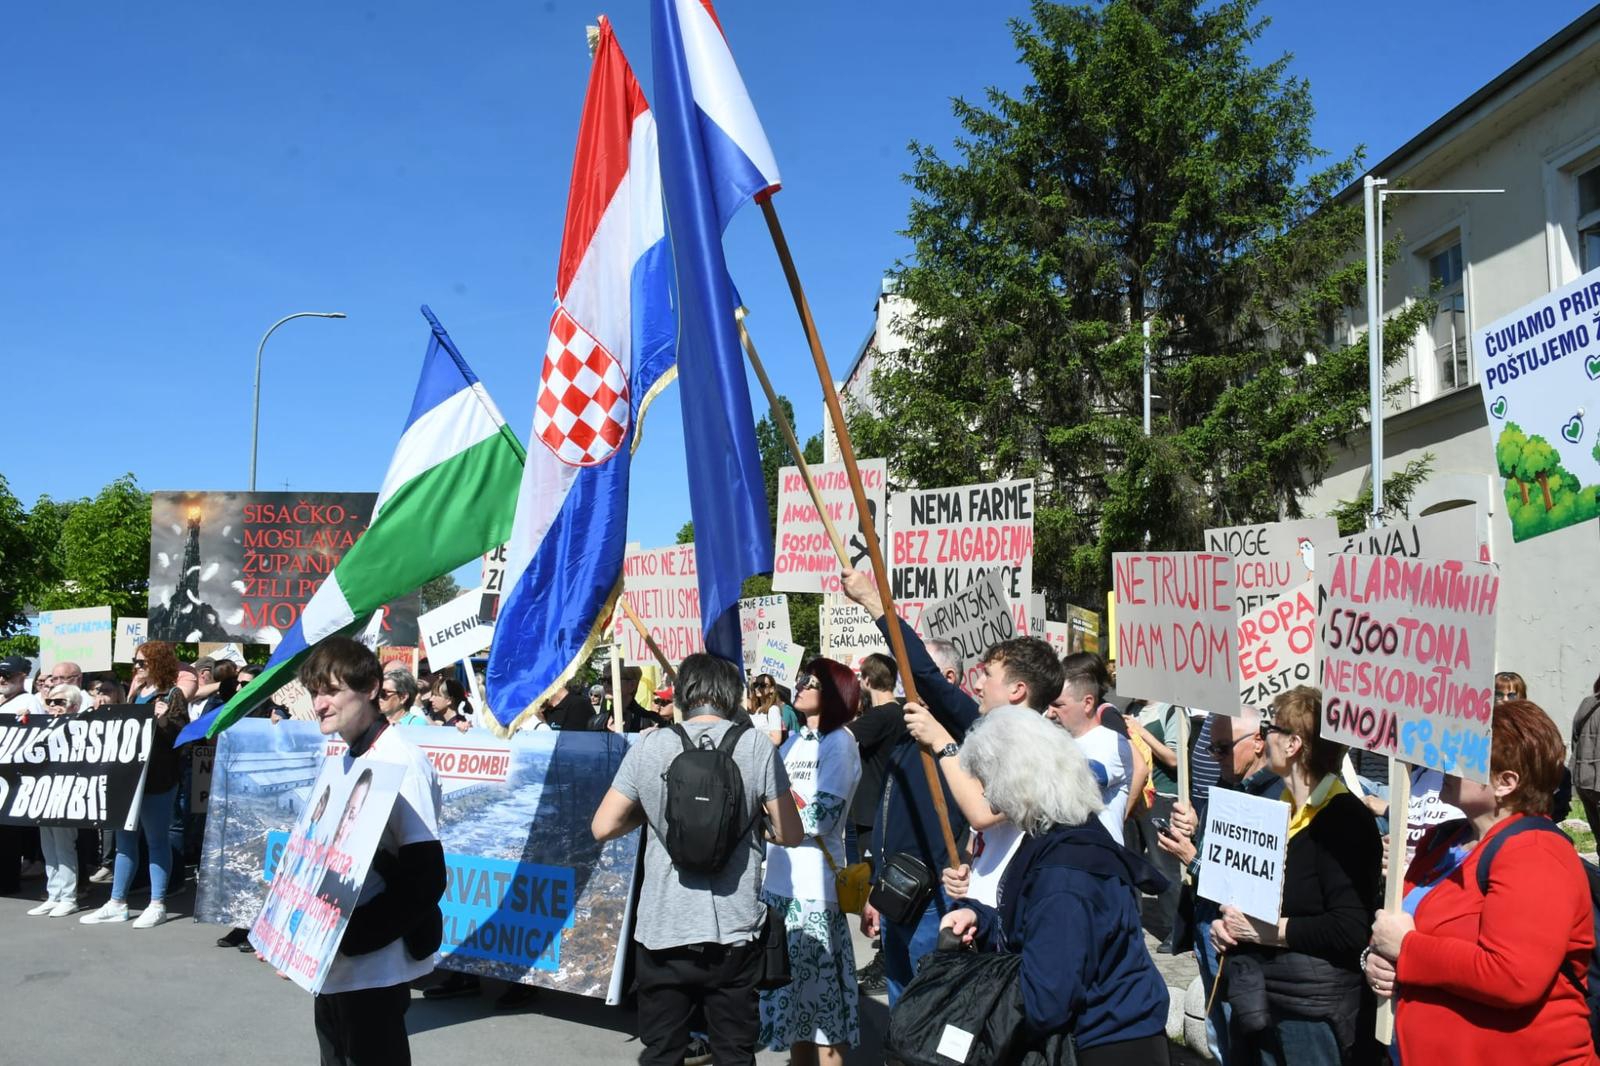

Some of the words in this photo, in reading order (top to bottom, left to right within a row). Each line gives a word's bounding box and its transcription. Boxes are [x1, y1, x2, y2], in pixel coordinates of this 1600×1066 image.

[1485, 306, 1556, 357] ČUVAMO
[1486, 324, 1590, 390] POŠTUJEMO
[243, 501, 345, 524] SISAČKO
[911, 491, 963, 526] NEMA
[969, 483, 1032, 522] FARME
[894, 530, 929, 565] BEZ
[936, 525, 1034, 567] ZAGAĐENJA
[1210, 528, 1270, 557] NOGE
[624, 553, 658, 577] NITKO
[660, 551, 676, 576] NE
[891, 566, 938, 599] NEMA
[1116, 556, 1146, 604] NE
[1146, 554, 1231, 612] TRUJTE
[1330, 555, 1499, 615] ALARMANTNIH
[242, 575, 291, 598] ŽELI
[667, 588, 675, 619] U
[927, 581, 1000, 637] HRVATSKA
[1119, 621, 1167, 671] NAM
[1173, 621, 1231, 683] DOM
[1330, 608, 1398, 655] 57500
[1397, 617, 1471, 670] TONA
[763, 656, 785, 670] NEMA
[1240, 663, 1310, 705] ZAŠTO
[1326, 697, 1398, 752] GNOJA
[457, 753, 510, 776] BOMBI!
[9, 774, 108, 821] BOMBI!
[1212, 819, 1278, 851] INVESTITORI
[1208, 843, 1222, 864] IZ
[1225, 848, 1275, 881] PAKLA!
